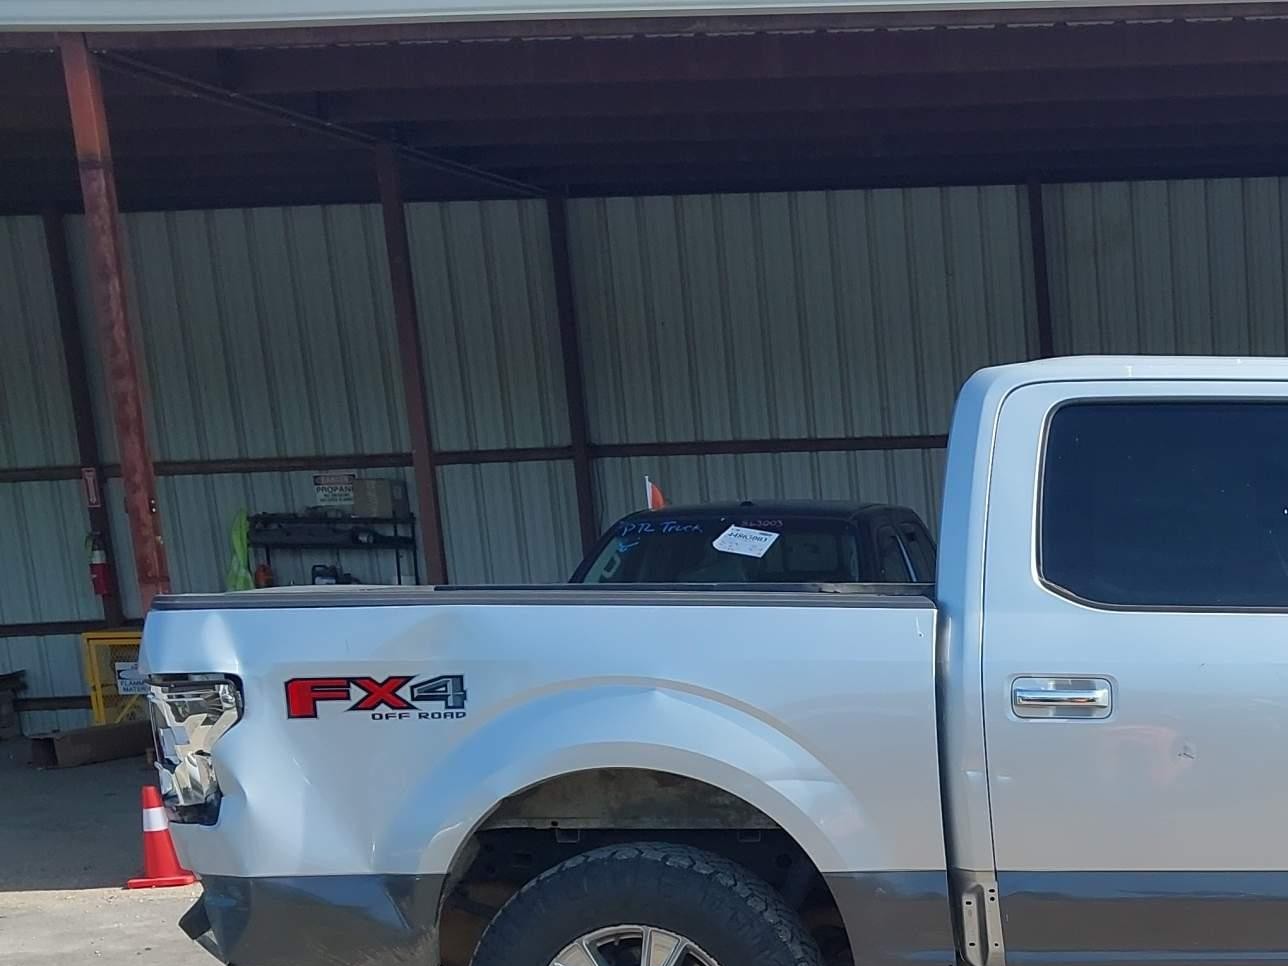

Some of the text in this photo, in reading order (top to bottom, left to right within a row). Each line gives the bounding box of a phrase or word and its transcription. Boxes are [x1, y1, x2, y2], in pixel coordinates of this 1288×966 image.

[284, 674, 467, 720] FX4
[371, 711, 467, 720] OFF ROAD
